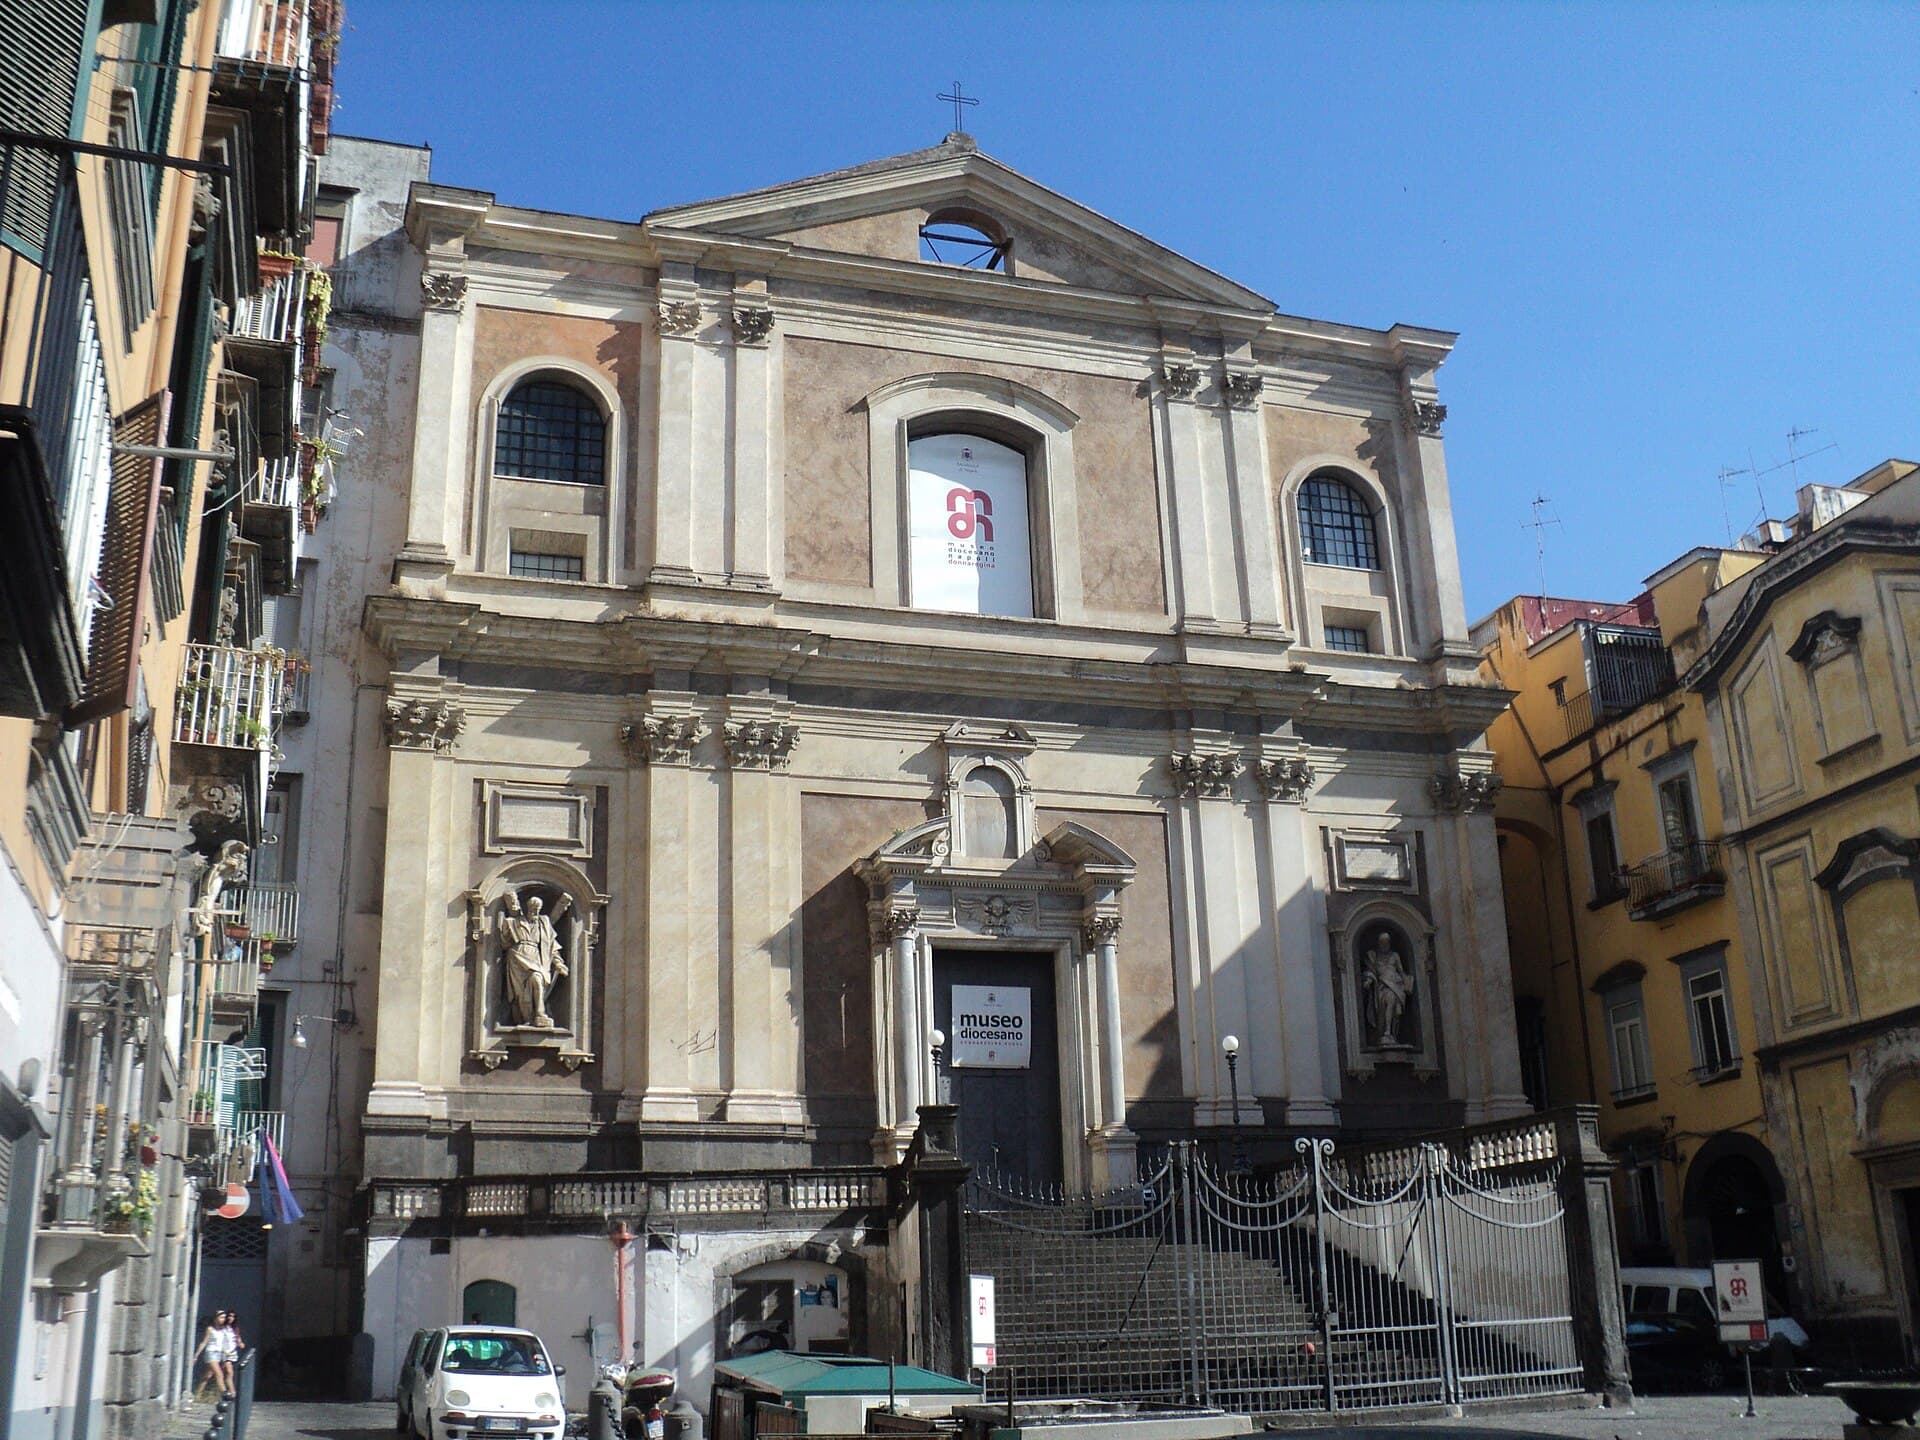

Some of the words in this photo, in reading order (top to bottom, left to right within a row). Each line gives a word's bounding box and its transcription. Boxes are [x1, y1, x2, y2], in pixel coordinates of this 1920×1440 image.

[947, 542, 994, 550] museo
[948, 547, 995, 556] diocesano
[948, 553, 995, 562] napoli
[960, 1013, 1023, 1028] museo
[960, 1028, 1023, 1041] diocesano
